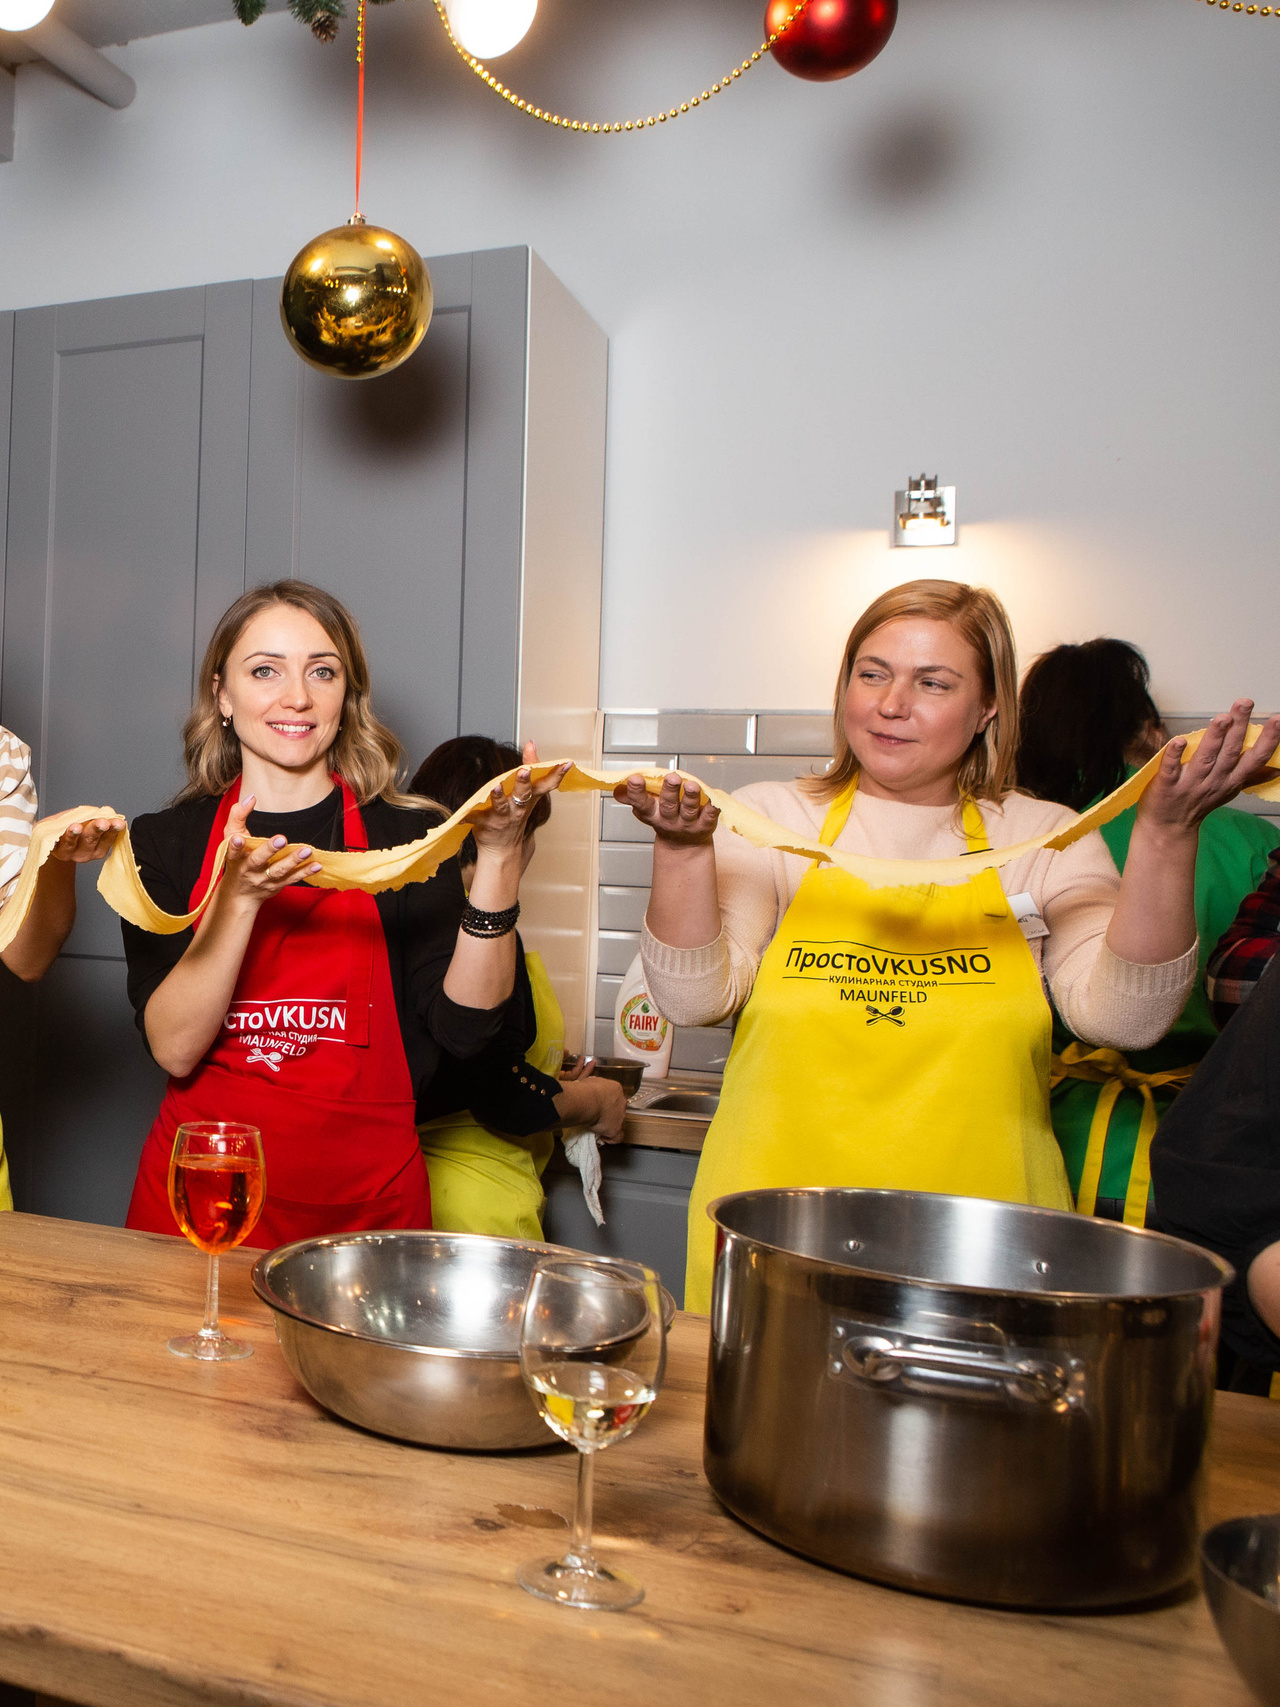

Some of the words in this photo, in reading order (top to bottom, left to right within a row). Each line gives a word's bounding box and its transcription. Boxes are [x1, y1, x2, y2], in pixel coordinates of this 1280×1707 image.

[785, 947, 992, 976] ПростоVKUSNO
[828, 975, 896, 987] КУЛИНАРНАЯ
[899, 979, 938, 988] СТУДИЯ
[840, 988, 928, 1003] MAUNFELD
[629, 1014, 660, 1031] FAIRY
[239, 1033, 307, 1056] MAUNFELD
